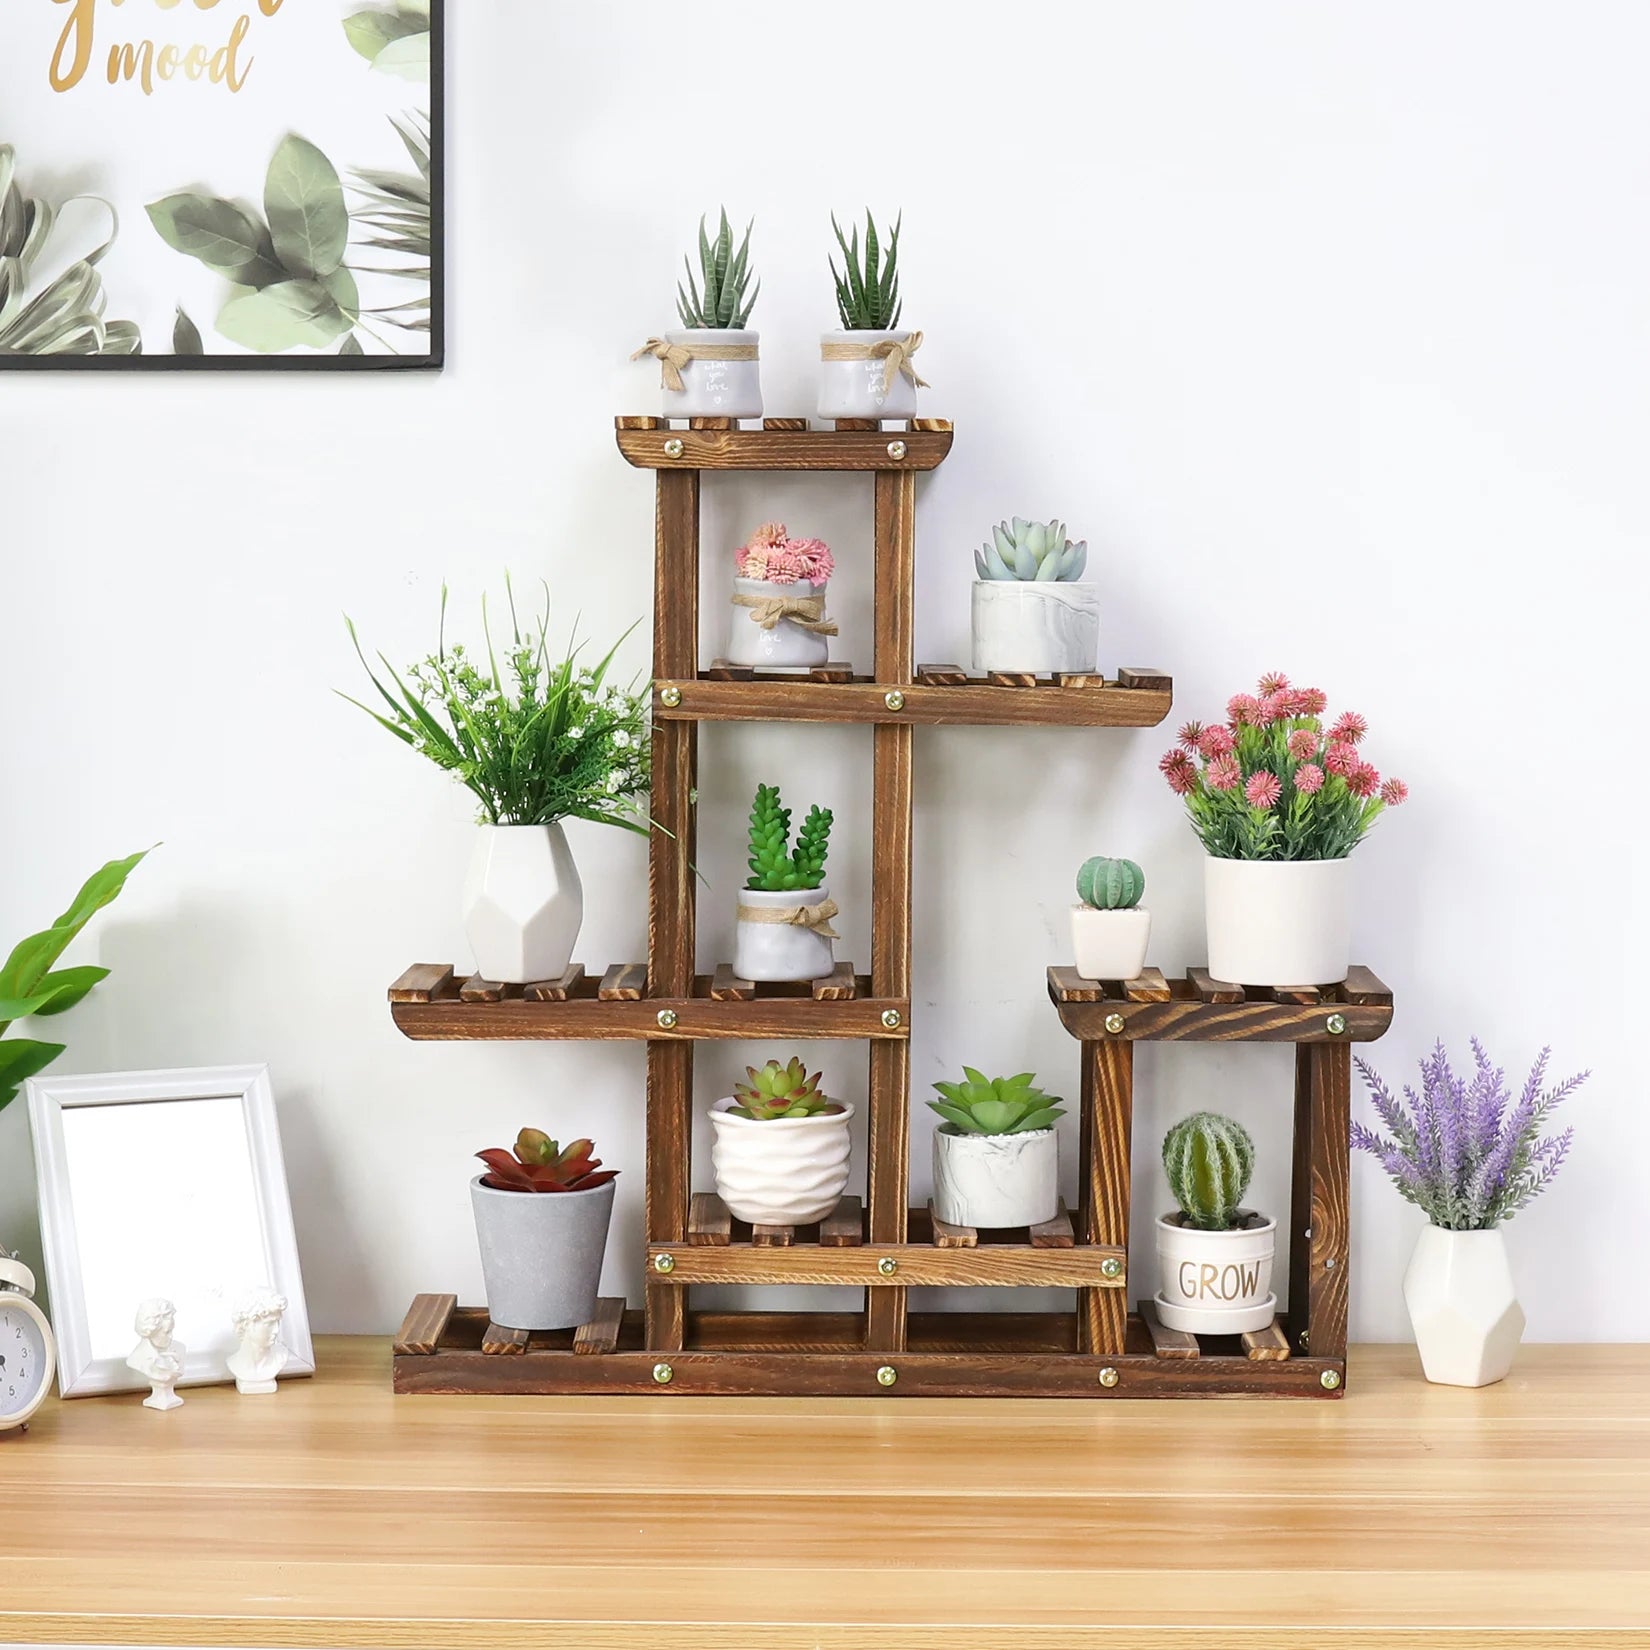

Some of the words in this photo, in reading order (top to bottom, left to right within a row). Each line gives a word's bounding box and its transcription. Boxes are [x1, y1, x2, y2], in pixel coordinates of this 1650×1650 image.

[107, 15, 255, 96] mood
[1179, 1260, 1261, 1301] GROW
[16, 1327, 21, 1339] 2
[21, 1347, 28, 1358] 3
[19, 1368, 25, 1377] 4
[9, 1385, 15, 1396] 5
